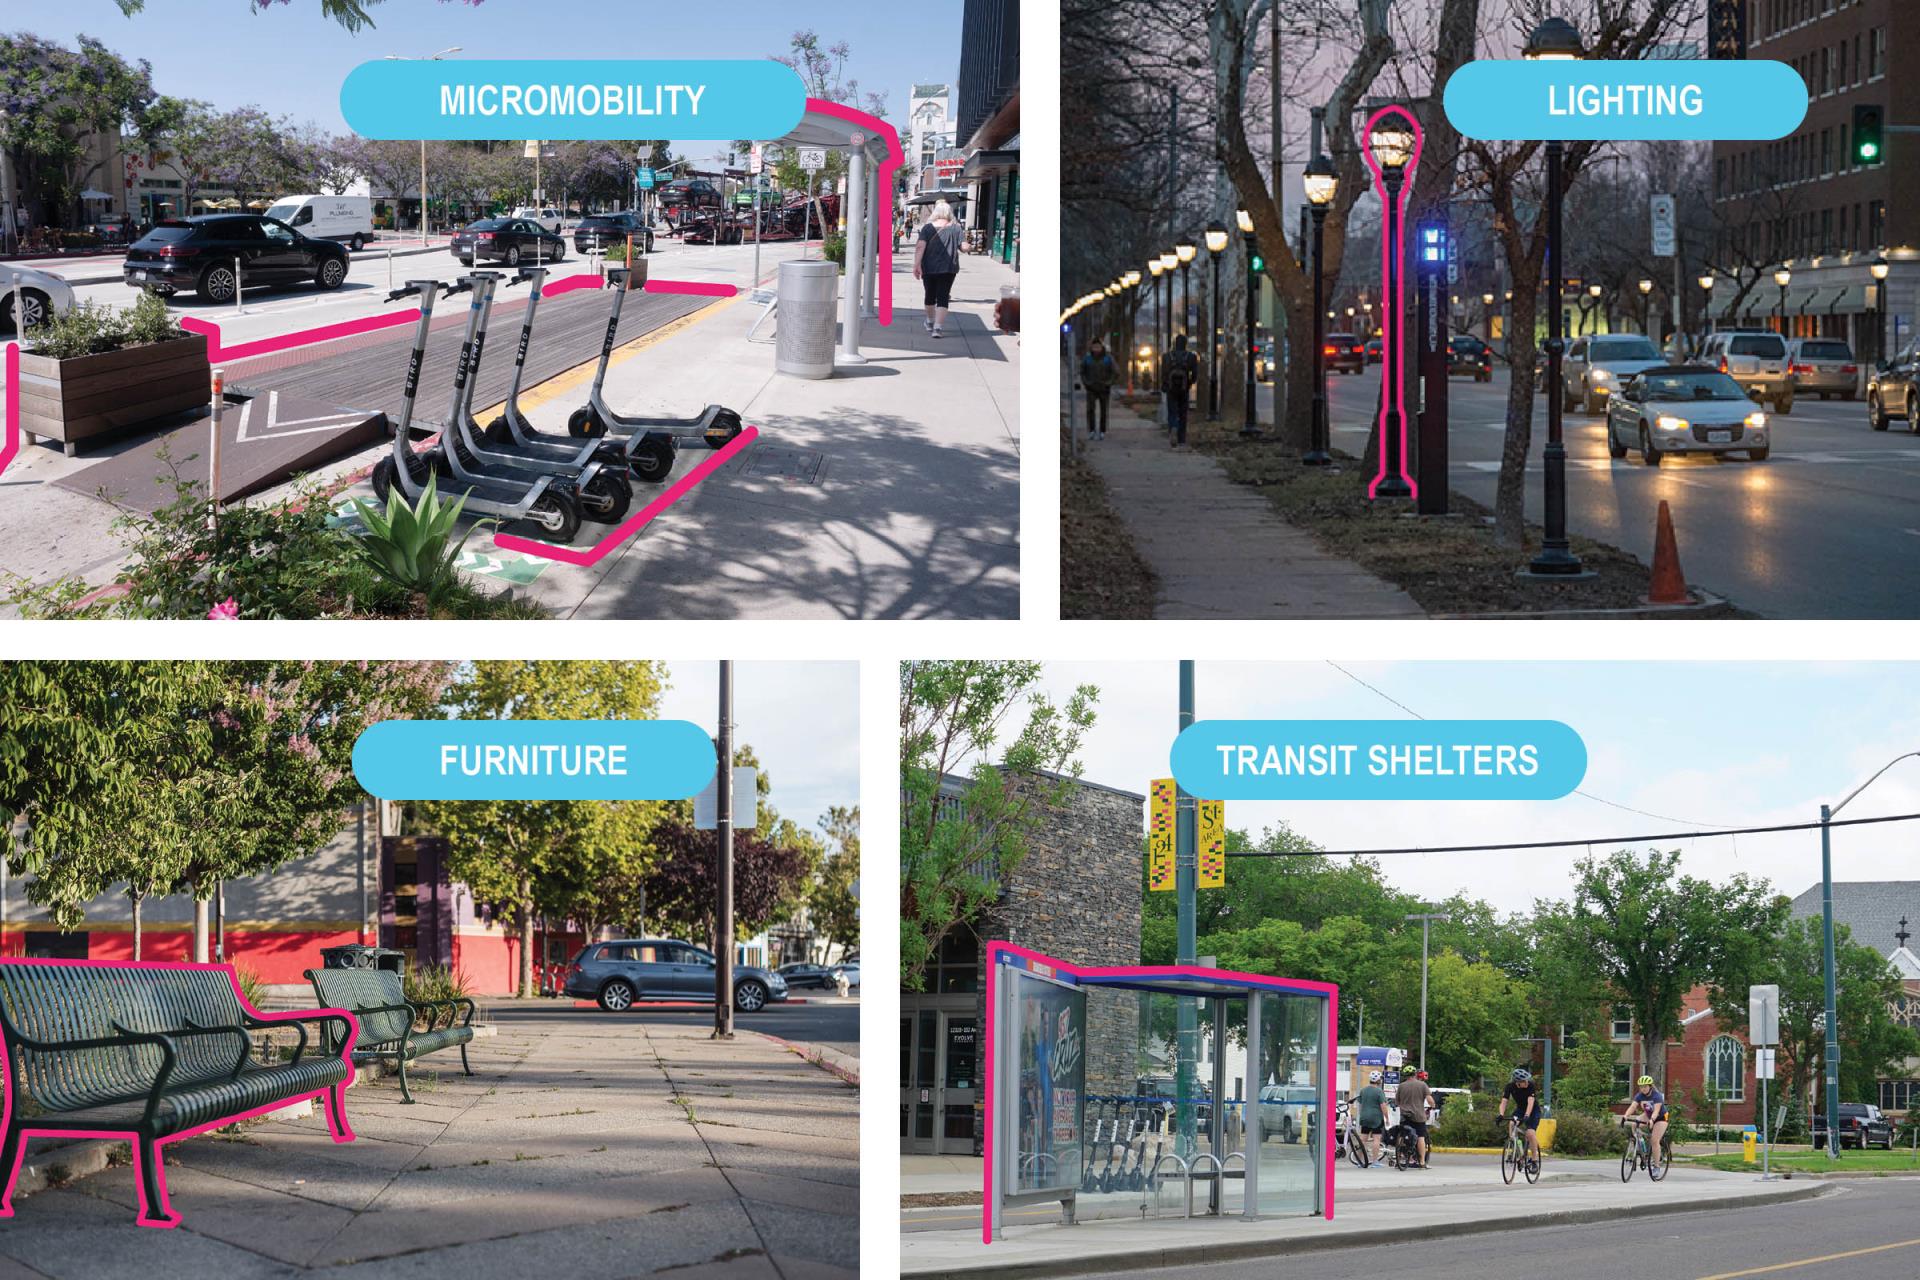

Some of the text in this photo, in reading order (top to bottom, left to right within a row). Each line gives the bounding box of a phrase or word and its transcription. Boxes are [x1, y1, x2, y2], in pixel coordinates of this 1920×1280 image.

[470, 338, 480, 366] BIRD
[517, 332, 529, 360] BIRD
[406, 358, 418, 388] BIRD
[456, 351, 469, 380] BIRD
[1201, 824, 1224, 843] AREA
[1153, 832, 1173, 866] 124
